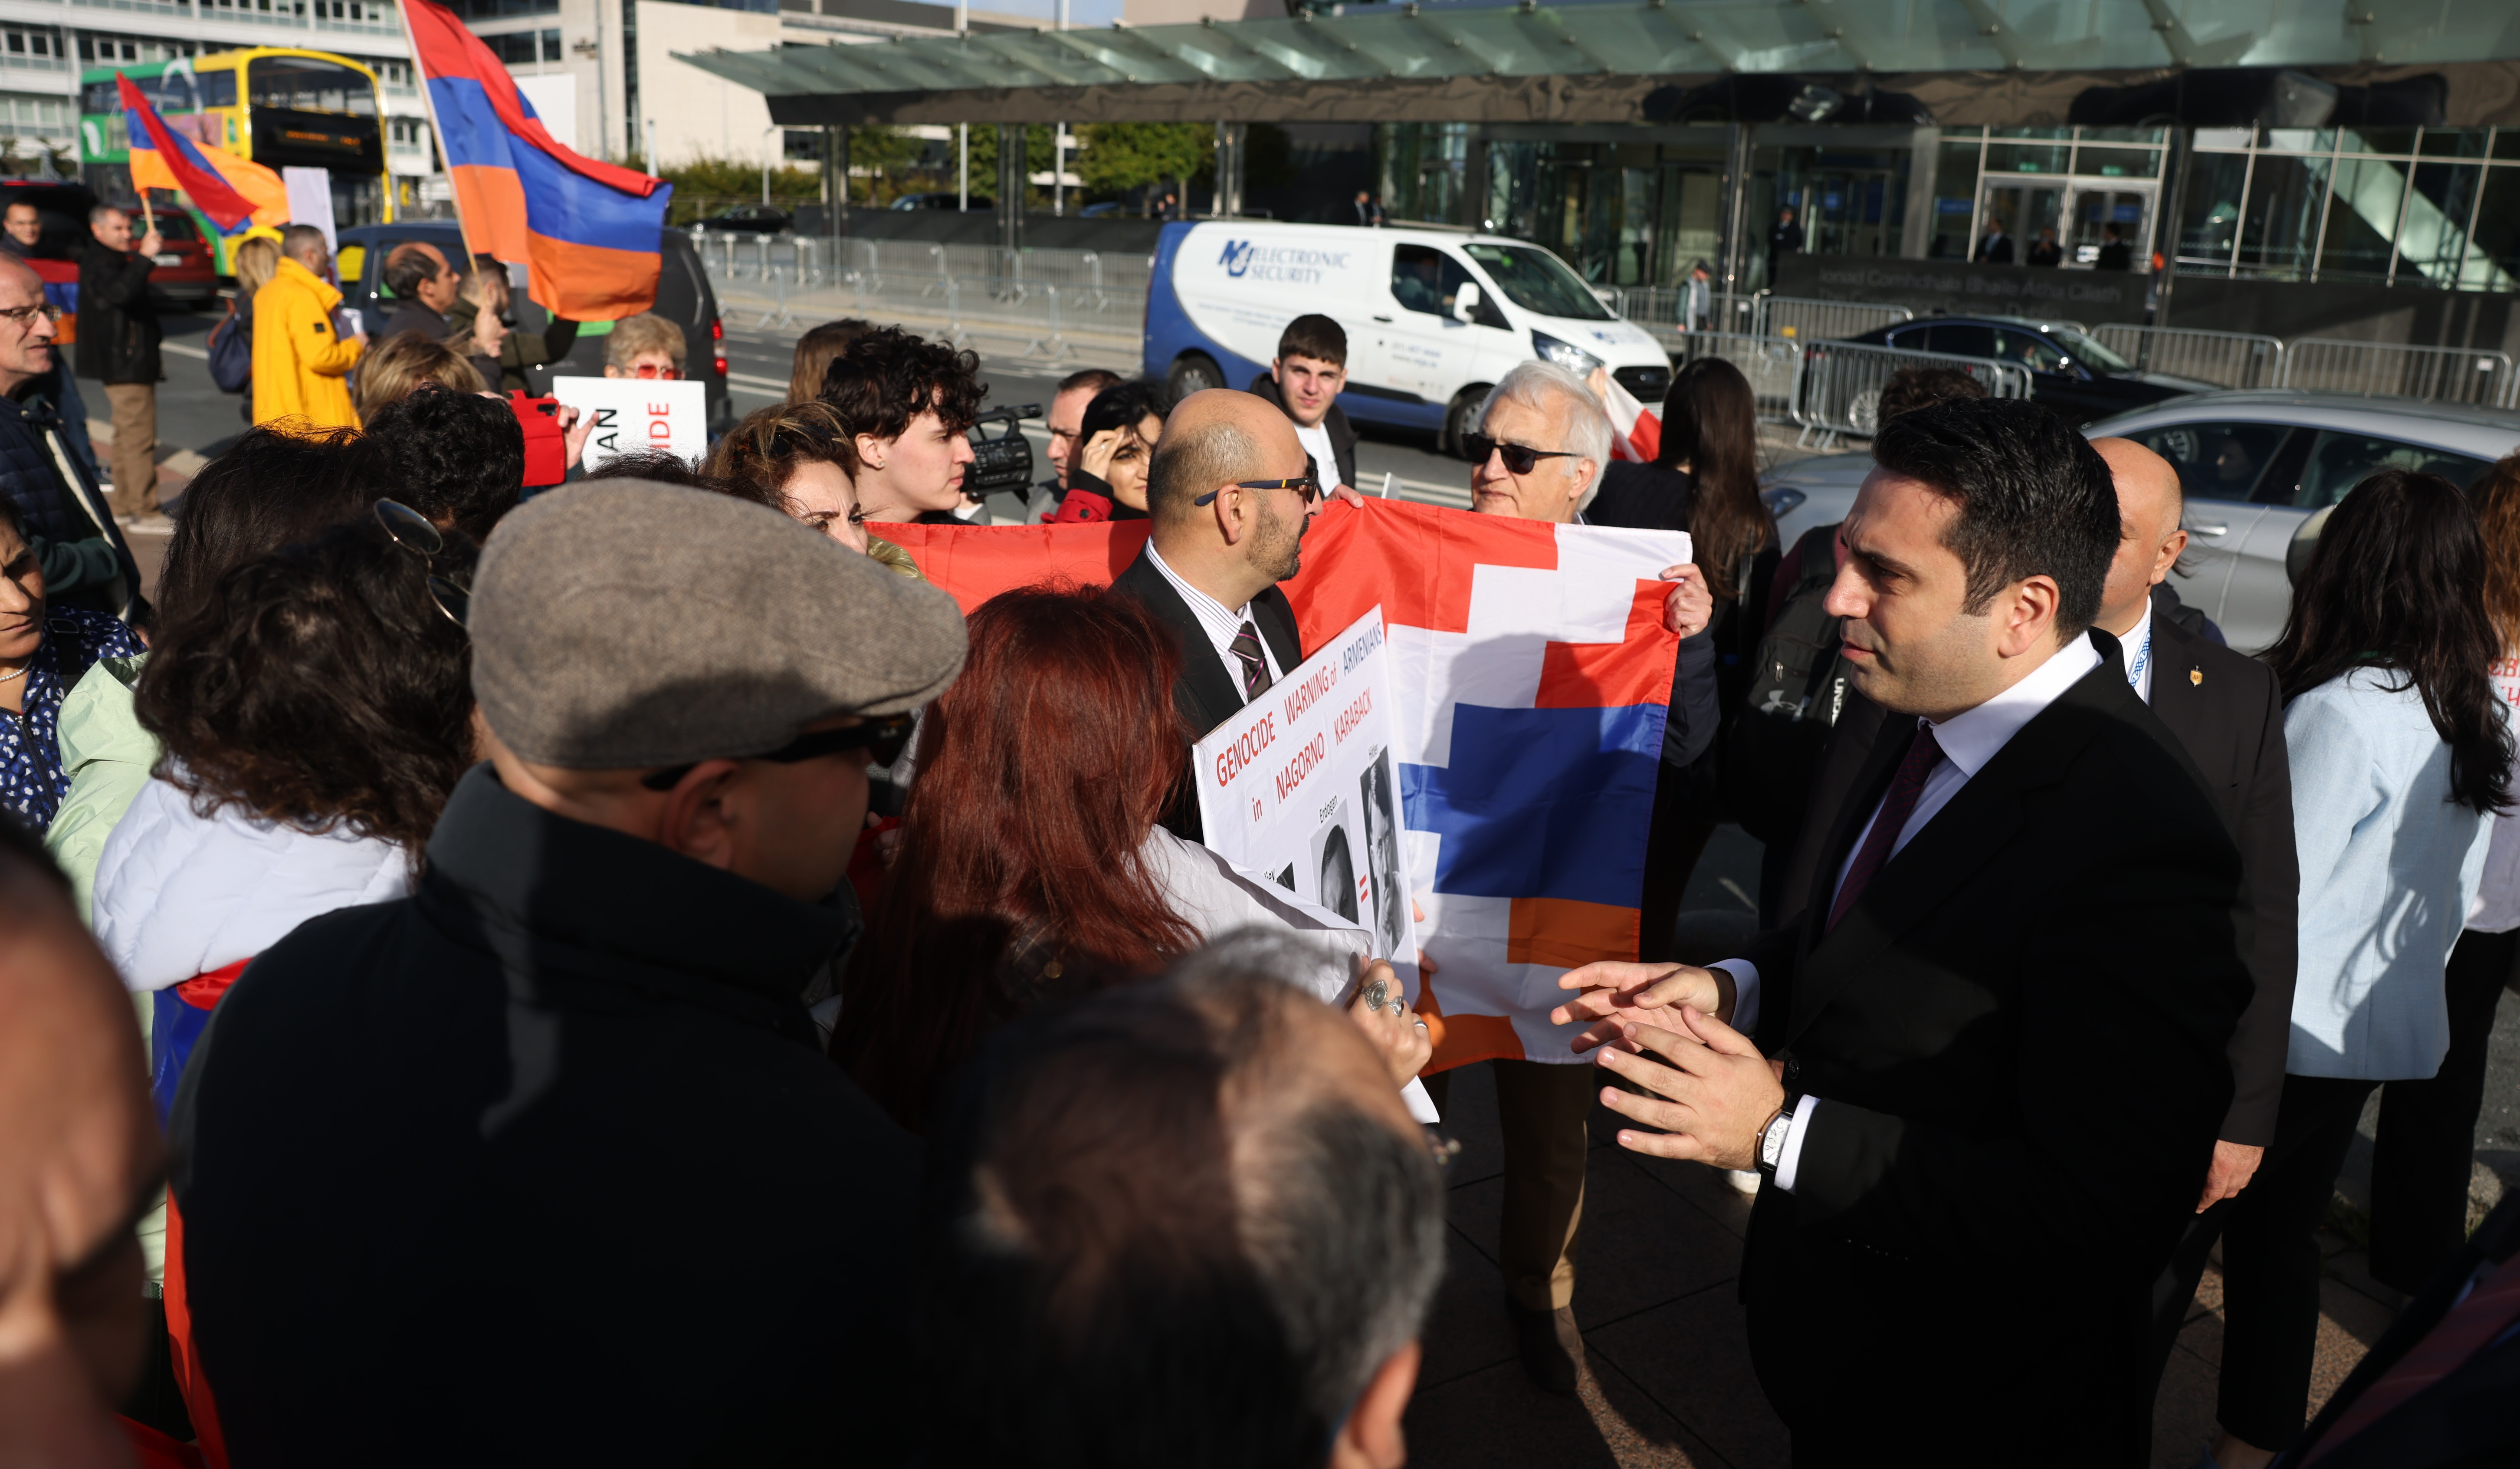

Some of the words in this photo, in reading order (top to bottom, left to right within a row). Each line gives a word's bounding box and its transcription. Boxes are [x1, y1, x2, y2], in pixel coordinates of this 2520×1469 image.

[1253, 247, 1351, 269] ELECTRONIC
[1250, 264, 1324, 284] SECURITY
[648, 403, 671, 450] IDE
[1216, 711, 1276, 787] GENOCIDE
[1284, 665, 1329, 726] WARNING
[1330, 661, 1338, 687] of
[1343, 621, 1381, 677] ARMENIANS
[1252, 797, 1263, 823] in
[1276, 732, 1325, 805] NAGORNO
[1334, 686, 1373, 746] KARABACK
[1368, 743, 1378, 760] Hitler
[1319, 795, 1338, 824] Erdogan
